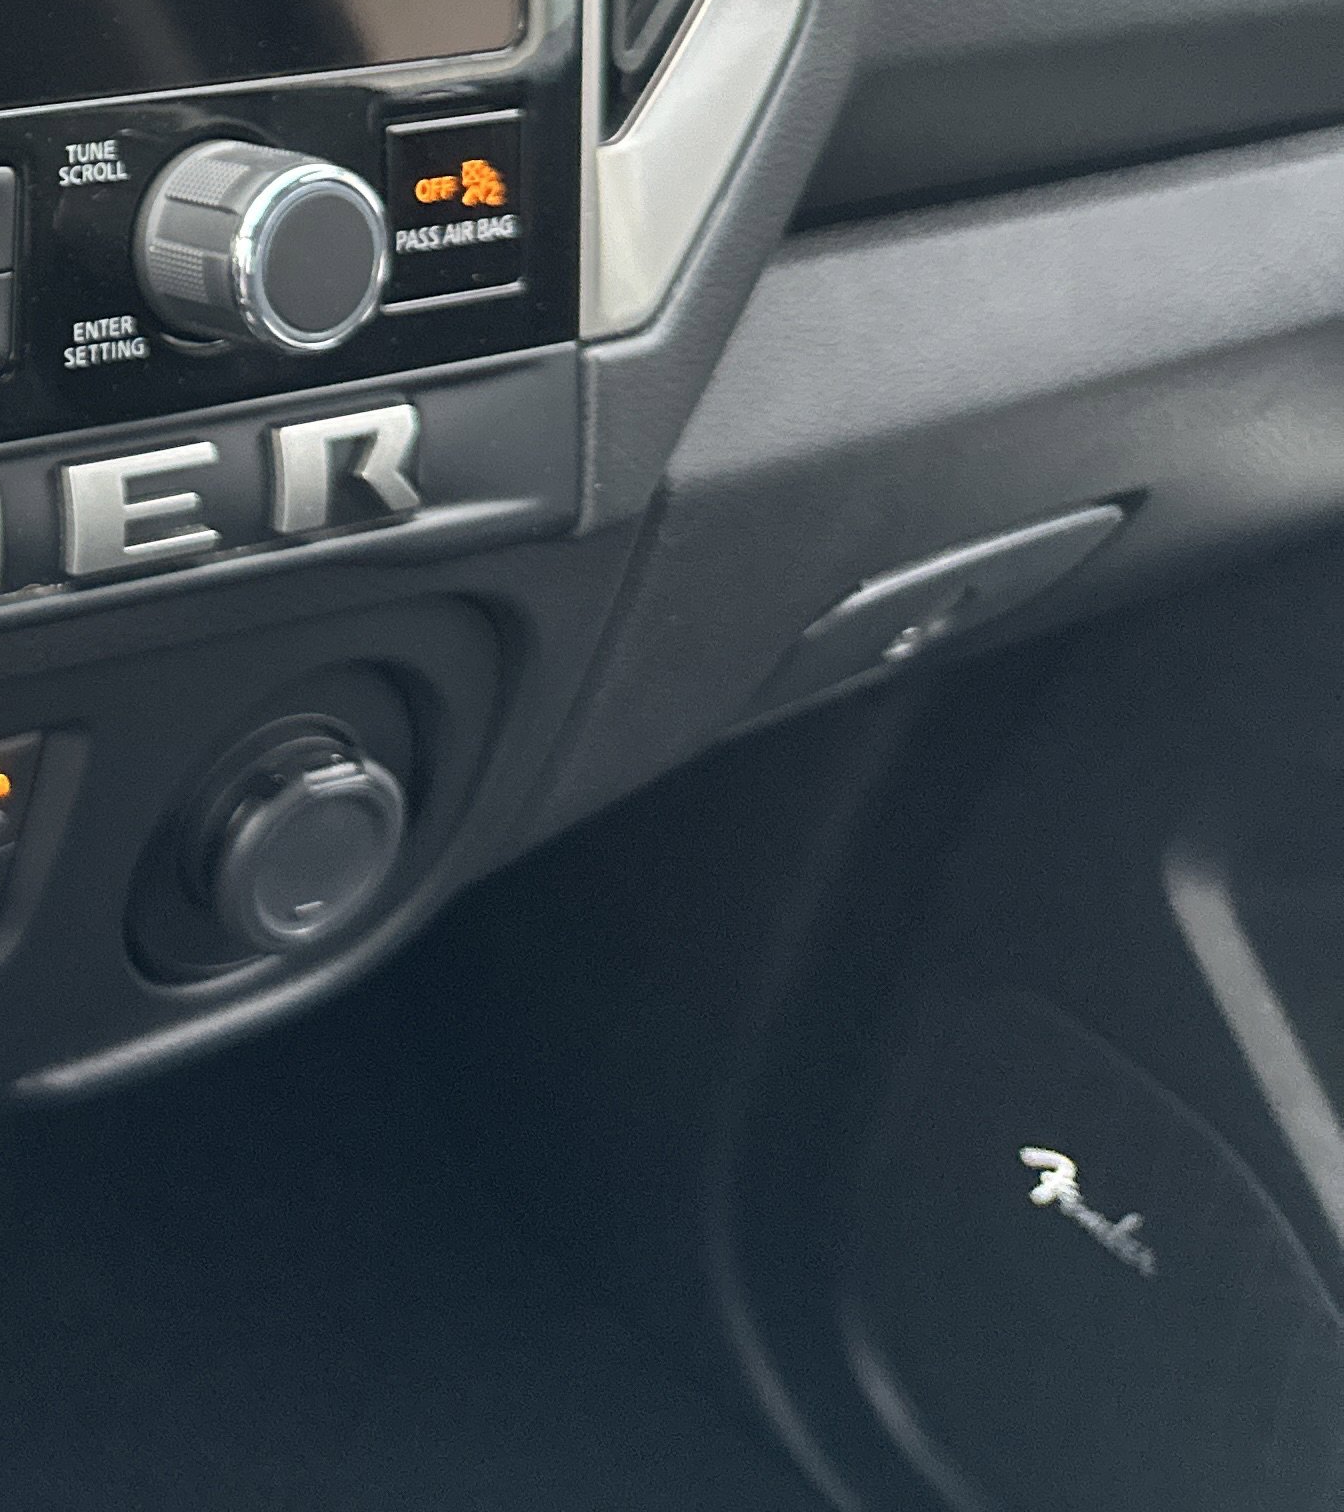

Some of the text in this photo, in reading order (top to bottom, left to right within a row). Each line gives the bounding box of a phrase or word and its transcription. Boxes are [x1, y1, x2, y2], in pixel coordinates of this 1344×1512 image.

[65, 139, 118, 165] TUNE
[58, 160, 130, 187] SCROLL
[415, 175, 459, 203] OFF
[395, 213, 519, 254] PASS AIR BAG
[73, 314, 136, 344] ENTER
[63, 336, 150, 369] SETTING
